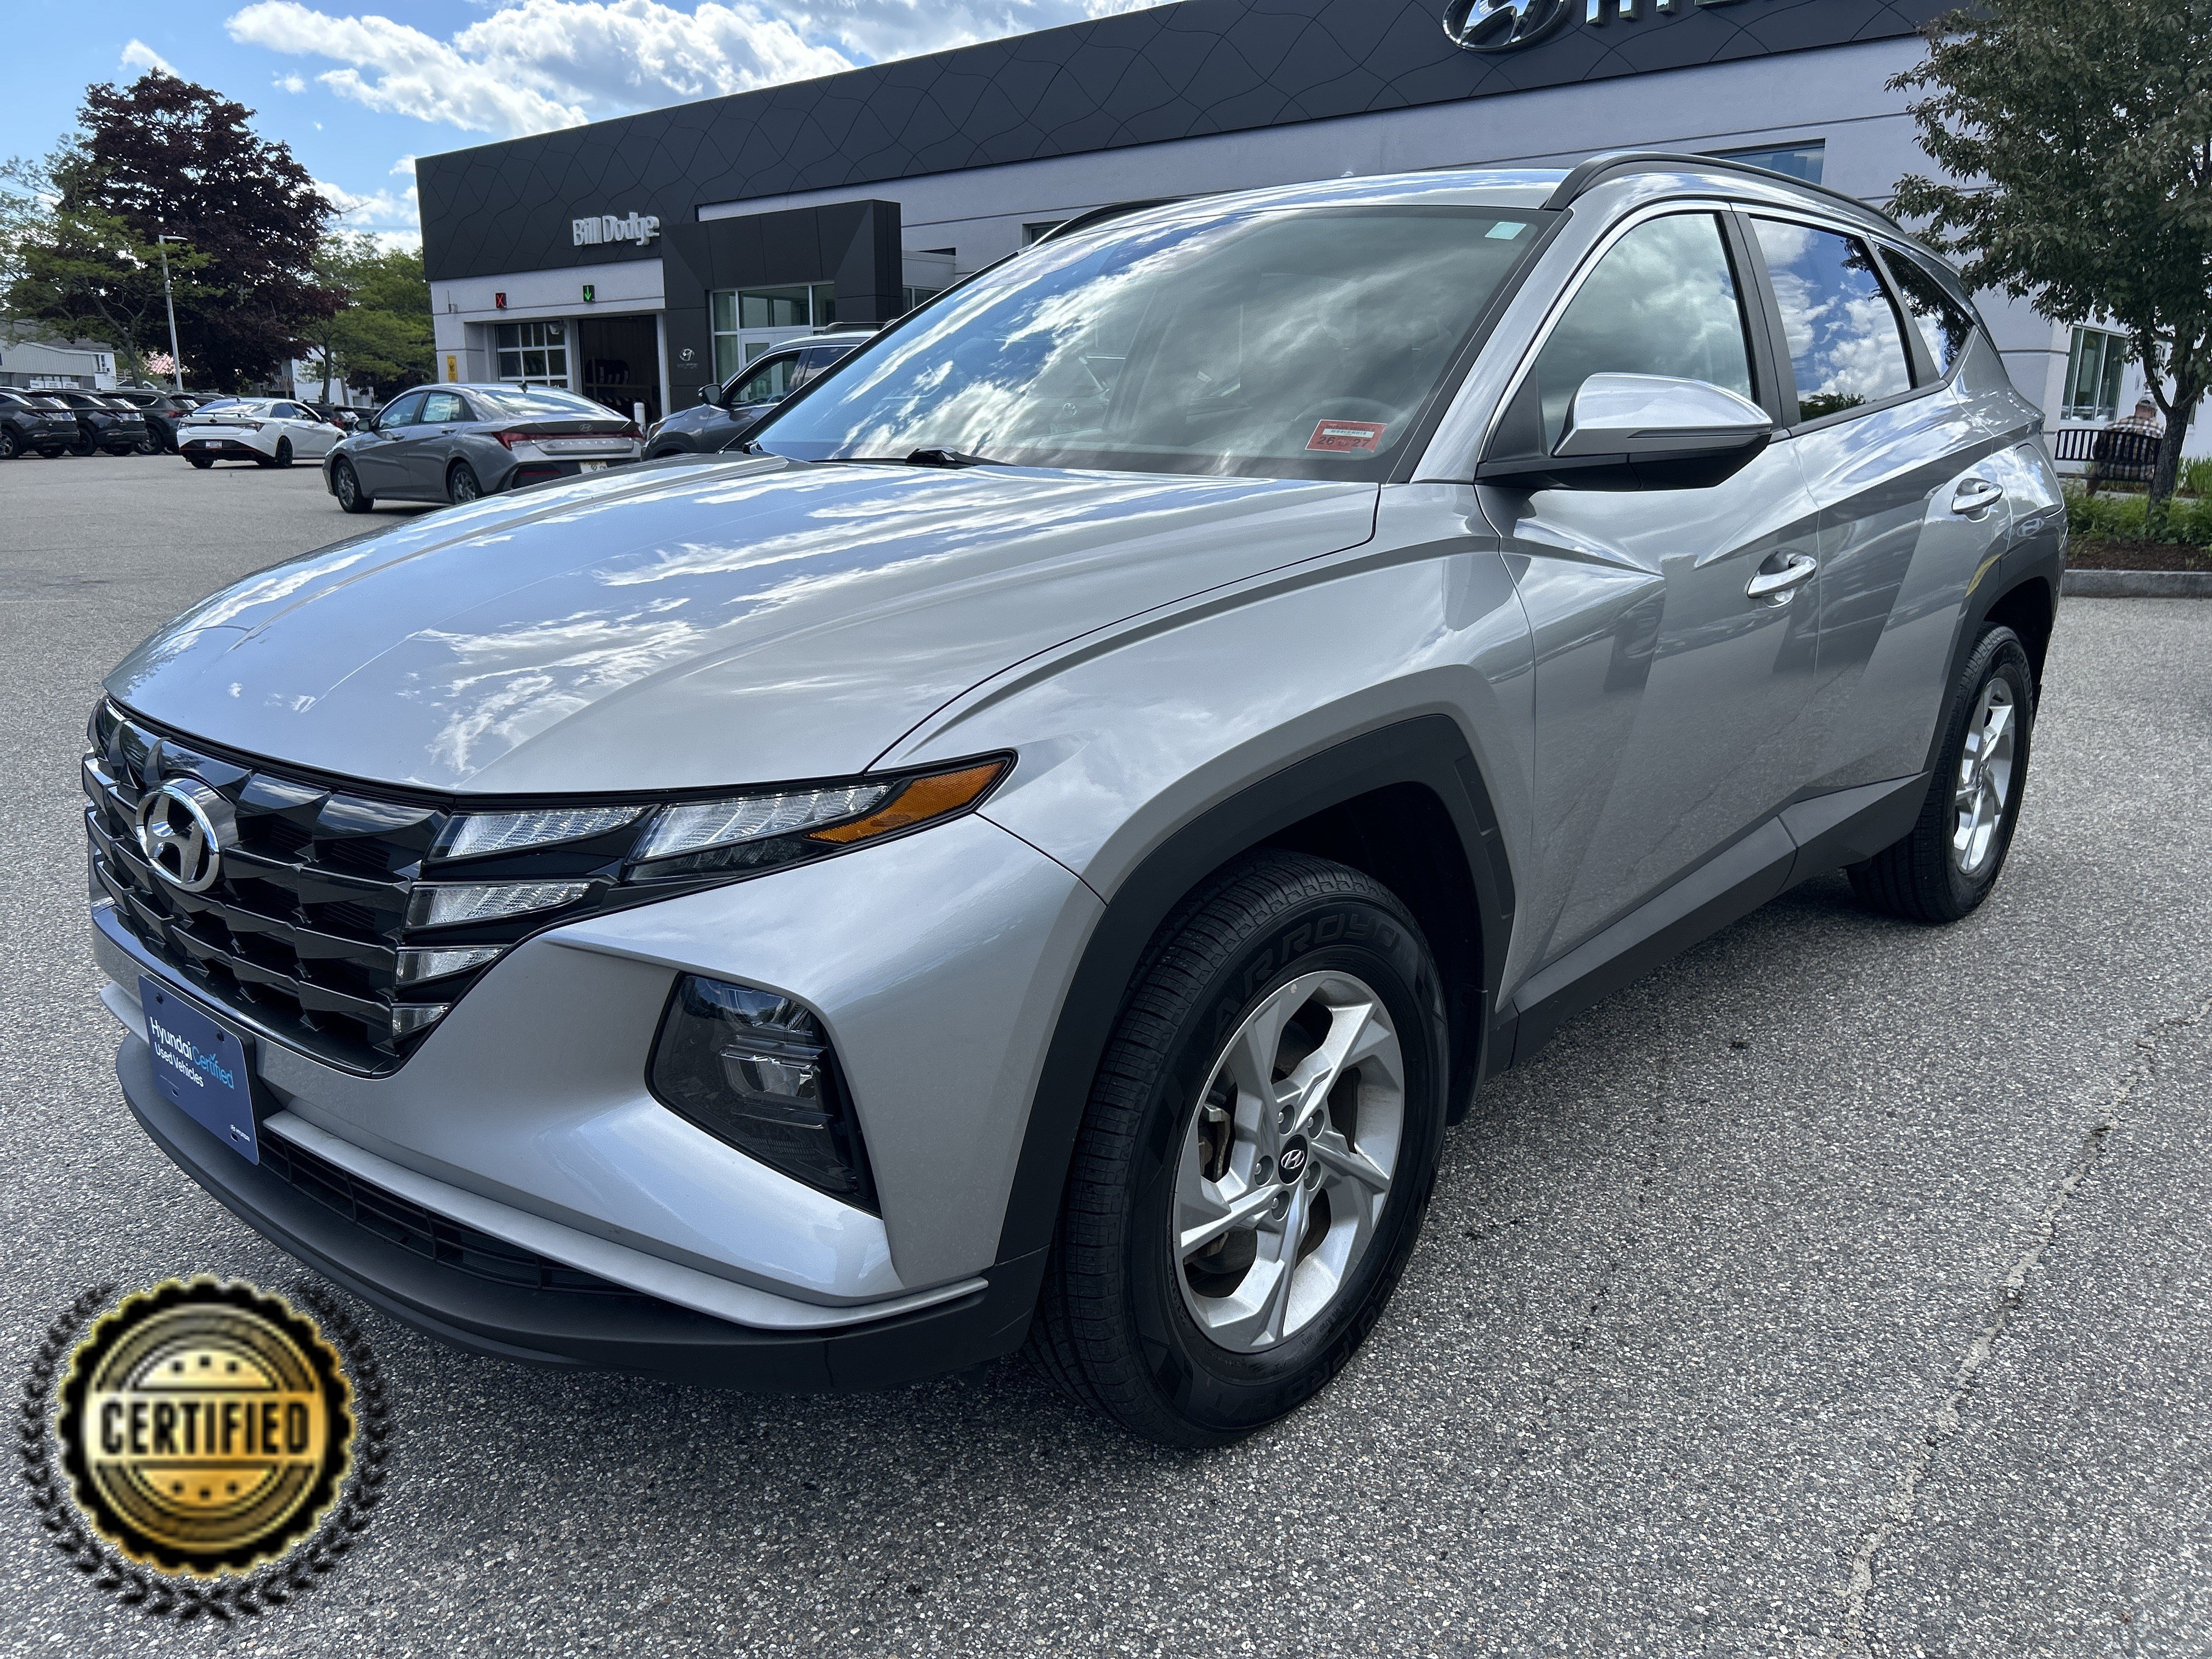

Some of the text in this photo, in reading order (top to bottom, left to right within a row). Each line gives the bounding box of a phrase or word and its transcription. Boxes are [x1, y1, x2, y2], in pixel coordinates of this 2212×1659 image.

[572, 212, 660, 246] Bill Dodge
[1317, 436, 1371, 447] 26 27
[150, 1016, 235, 1090] Hyundai Certified
[155, 1041, 204, 1087] Used Vehicles
